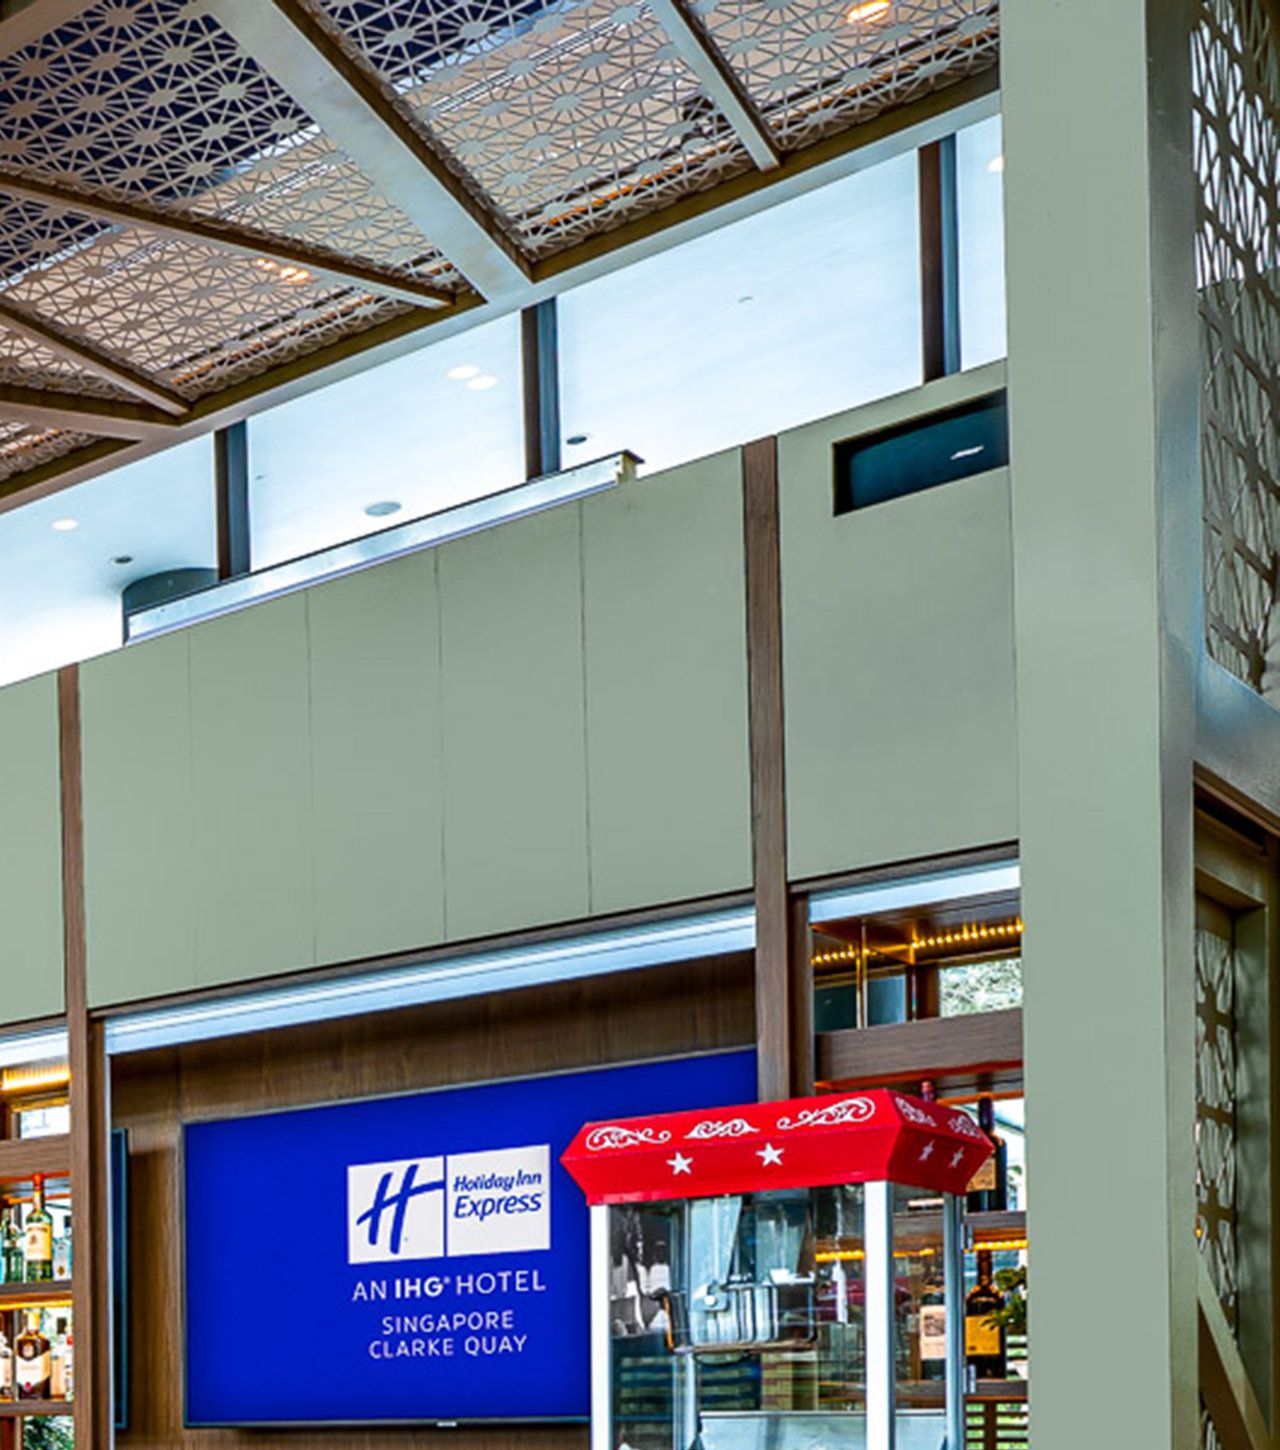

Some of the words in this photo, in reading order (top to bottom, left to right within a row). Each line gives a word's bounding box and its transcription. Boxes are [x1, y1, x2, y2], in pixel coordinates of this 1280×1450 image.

[453, 1173, 516, 1192] Holiday
[516, 1169, 542, 1187] Inn
[453, 1193, 542, 1221] Express
[352, 1281, 387, 1302] AN
[456, 1270, 546, 1296] HOTEL
[382, 1310, 513, 1335] SINGAPORE
[368, 1337, 454, 1360] CLARKE
[464, 1334, 527, 1357] QUAY
